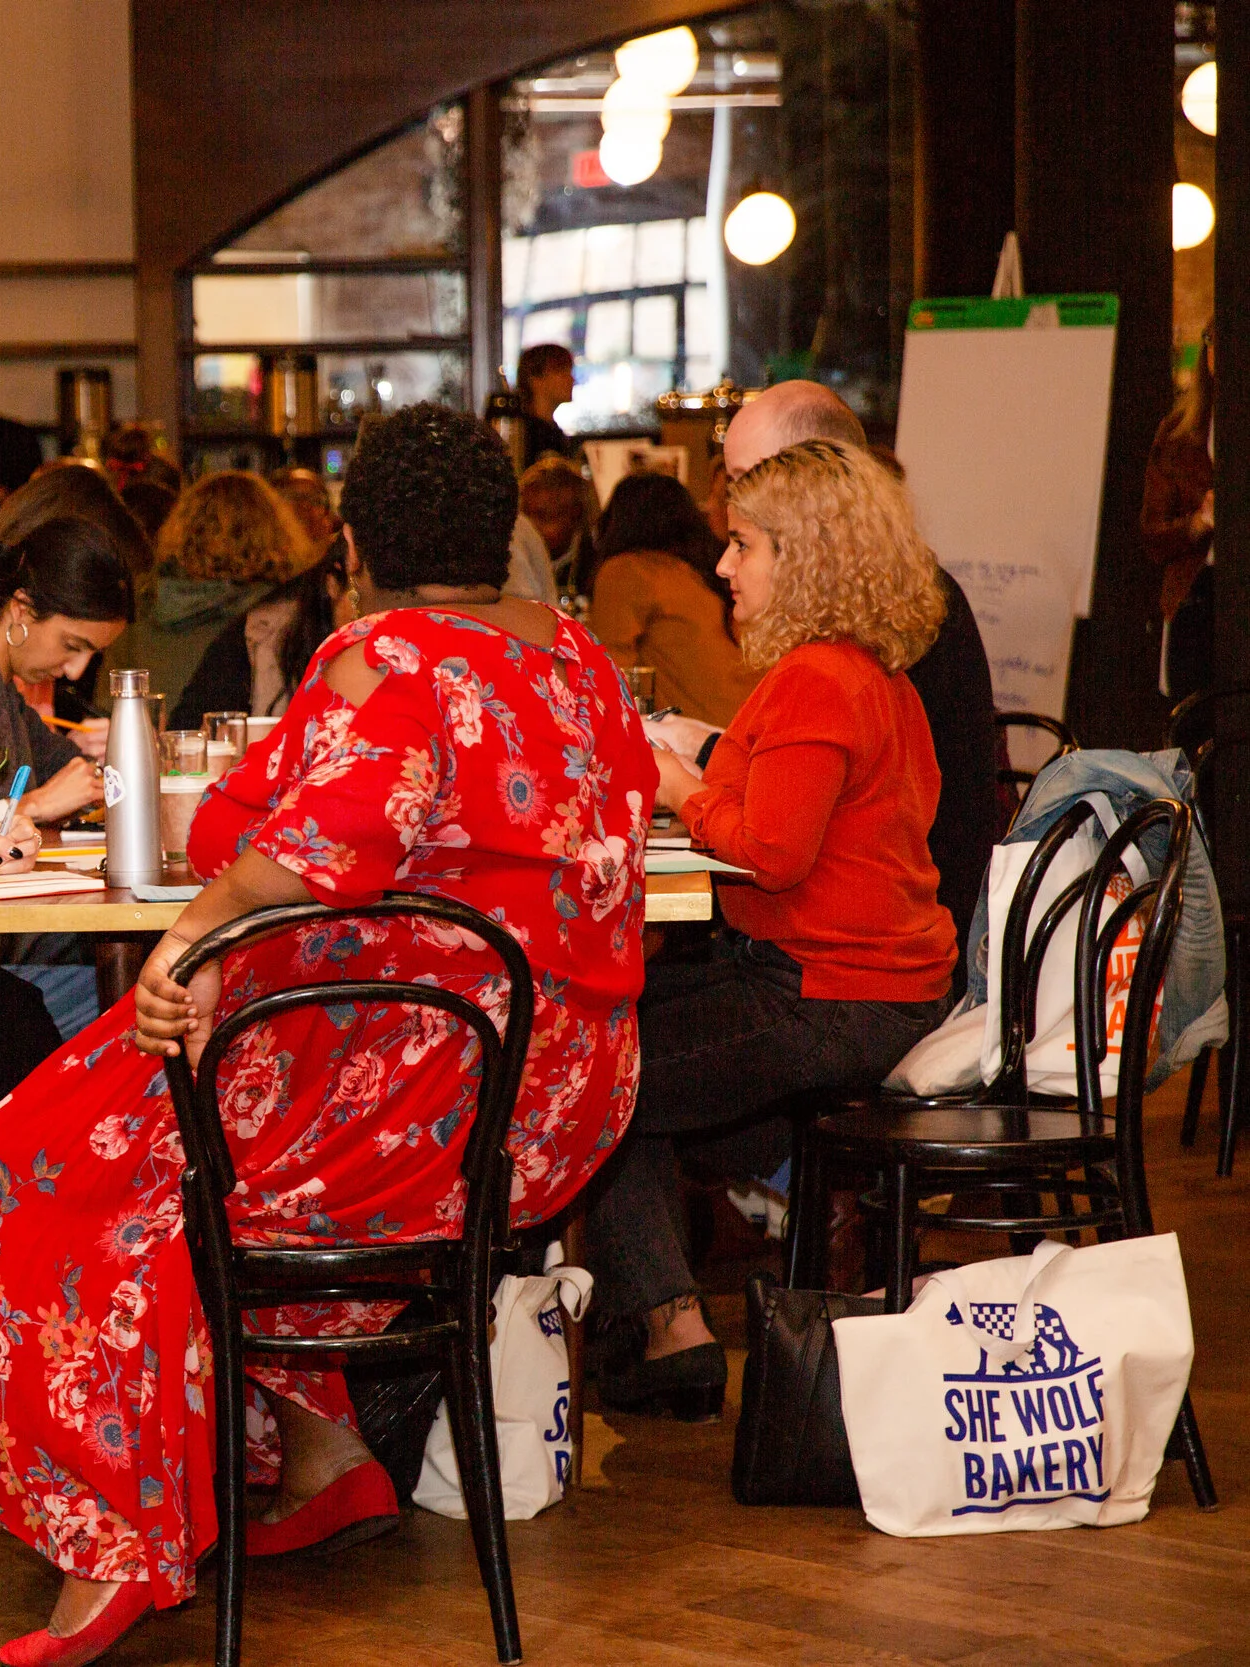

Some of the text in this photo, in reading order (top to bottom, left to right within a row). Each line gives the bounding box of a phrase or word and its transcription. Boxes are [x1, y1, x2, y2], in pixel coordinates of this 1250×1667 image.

[944, 1369, 1104, 1442] SHE WOLF
[963, 1433, 1104, 1500] BAKERY
